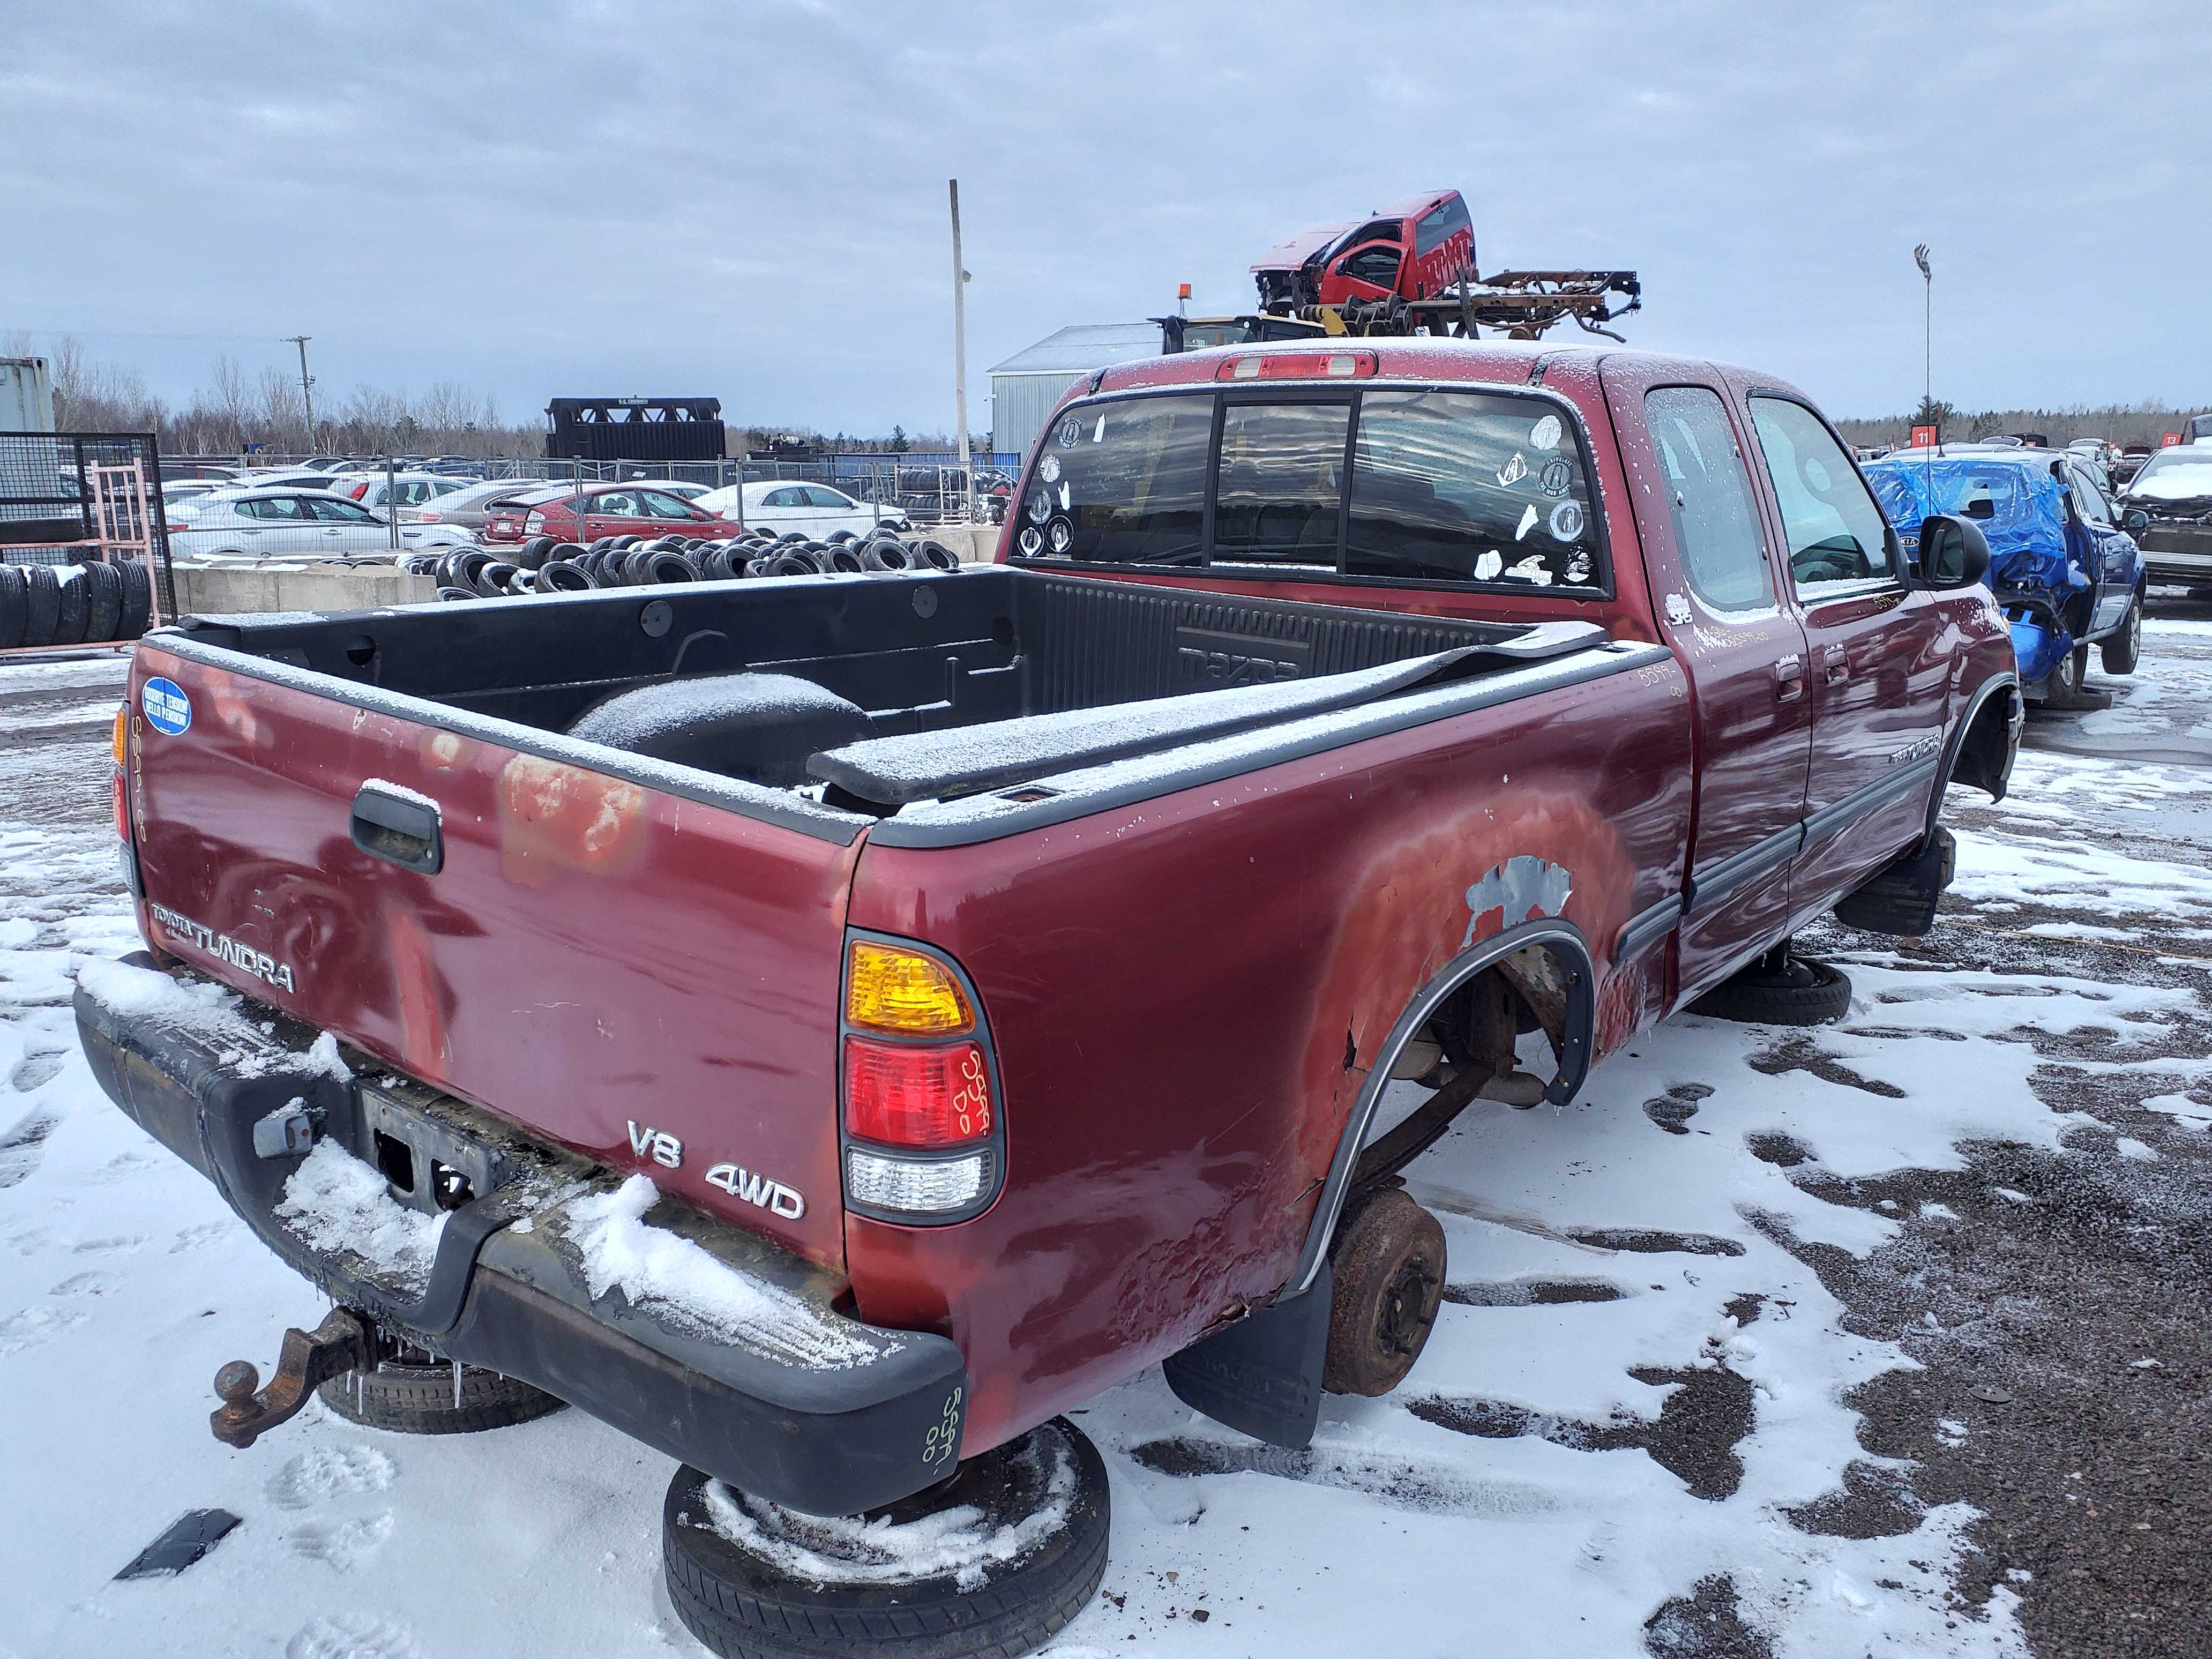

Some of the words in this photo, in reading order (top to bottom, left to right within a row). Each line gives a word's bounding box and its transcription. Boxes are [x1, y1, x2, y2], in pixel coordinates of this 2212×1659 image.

[1918, 432, 1928, 444] 11
[2166, 436, 2177, 444] 13
[145, 686, 165, 706] GOODBYE
[166, 693, 188, 714] TENSION!
[146, 700, 160, 717] HELLO
[162, 706, 186, 727] PENSION!
[151, 903, 192, 936] TOYOTA
[192, 923, 295, 994] TUNDRA
[627, 1119, 685, 1169] V8
[705, 1162, 806, 1221] 4WD
